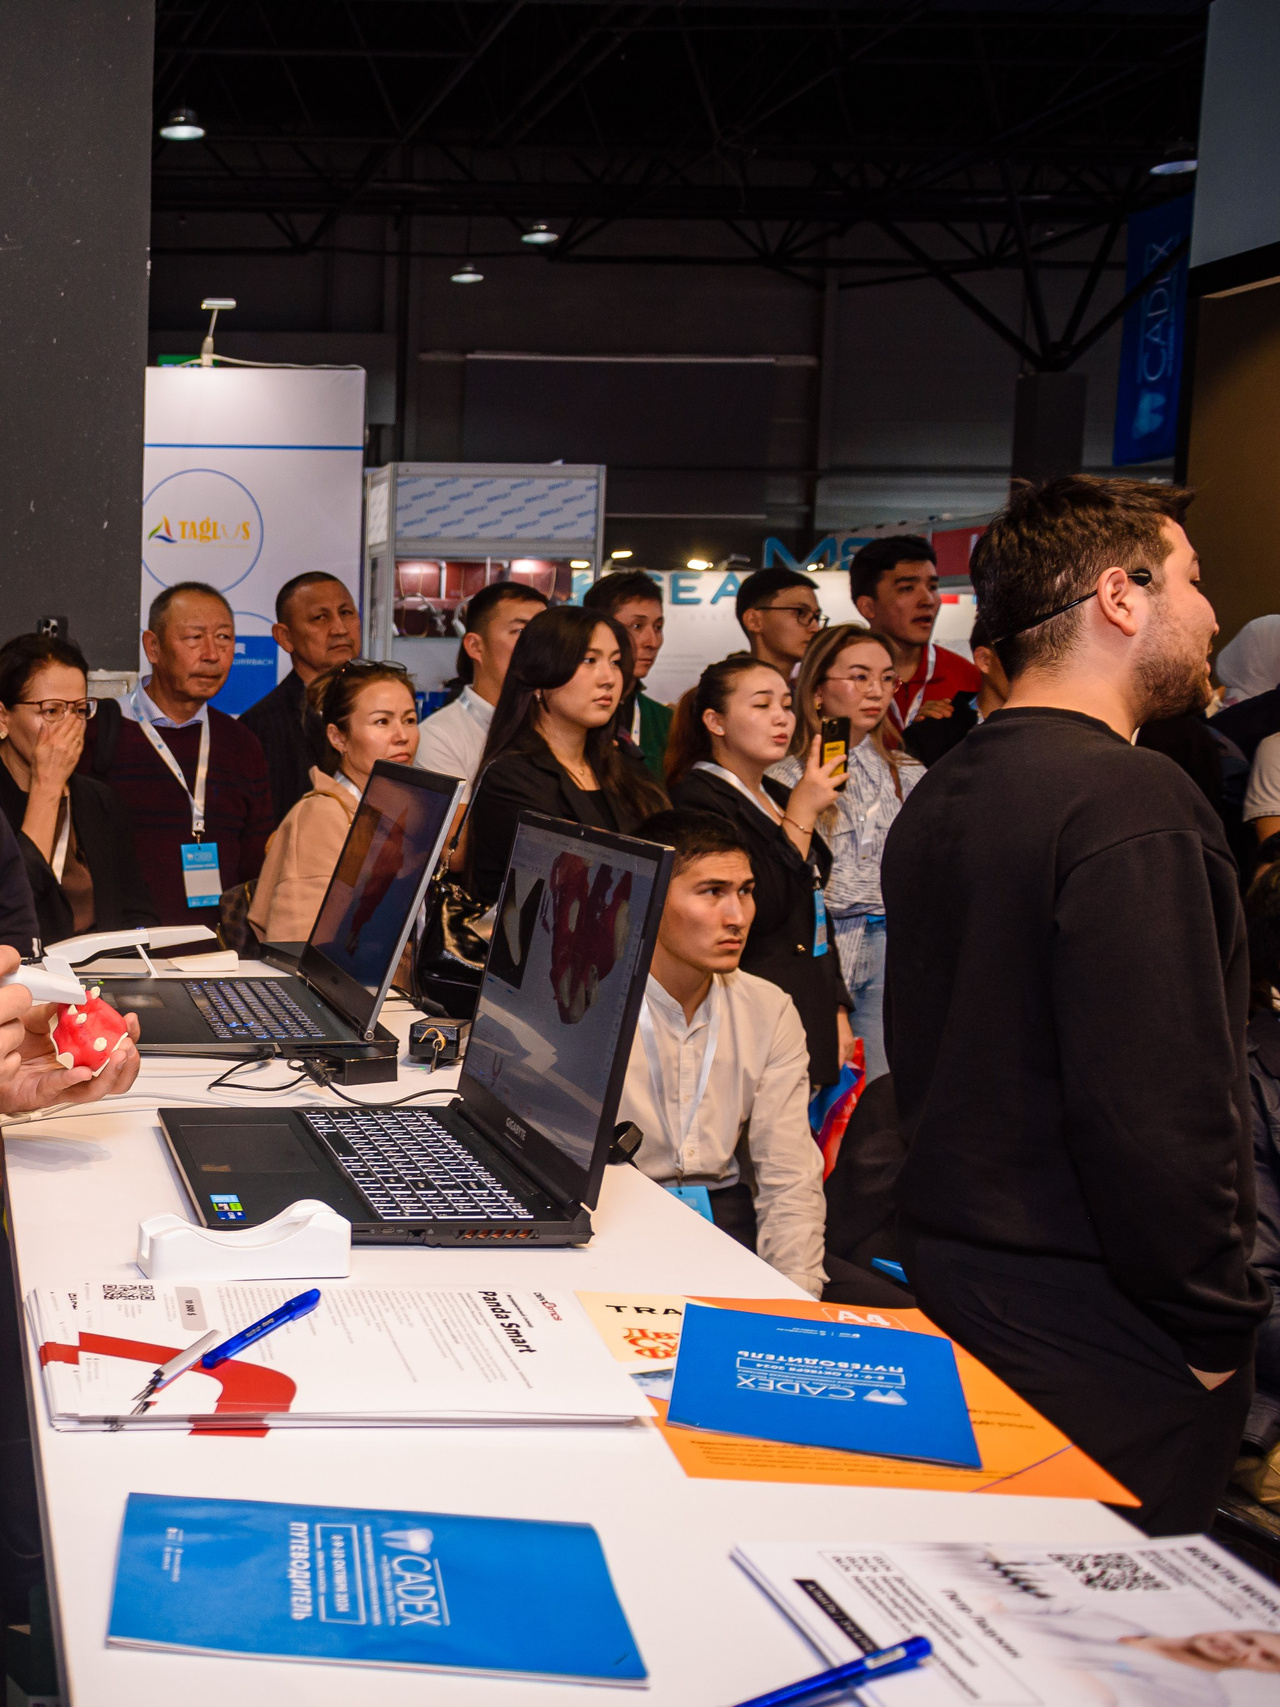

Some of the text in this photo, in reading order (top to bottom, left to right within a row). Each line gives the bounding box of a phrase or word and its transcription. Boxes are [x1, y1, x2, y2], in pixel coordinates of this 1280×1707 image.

[1142, 237, 1173, 382] CADX
[478, 1291, 537, 1353] Panda Smart
[736, 1375, 856, 1399] CADEX
[737, 1350, 904, 1373] ПУТЕВОДИТЕЛЬ
[288, 1521, 313, 1620] ПУТЕВОДИТЕЛЬ
[391, 1554, 442, 1627] CADEX
